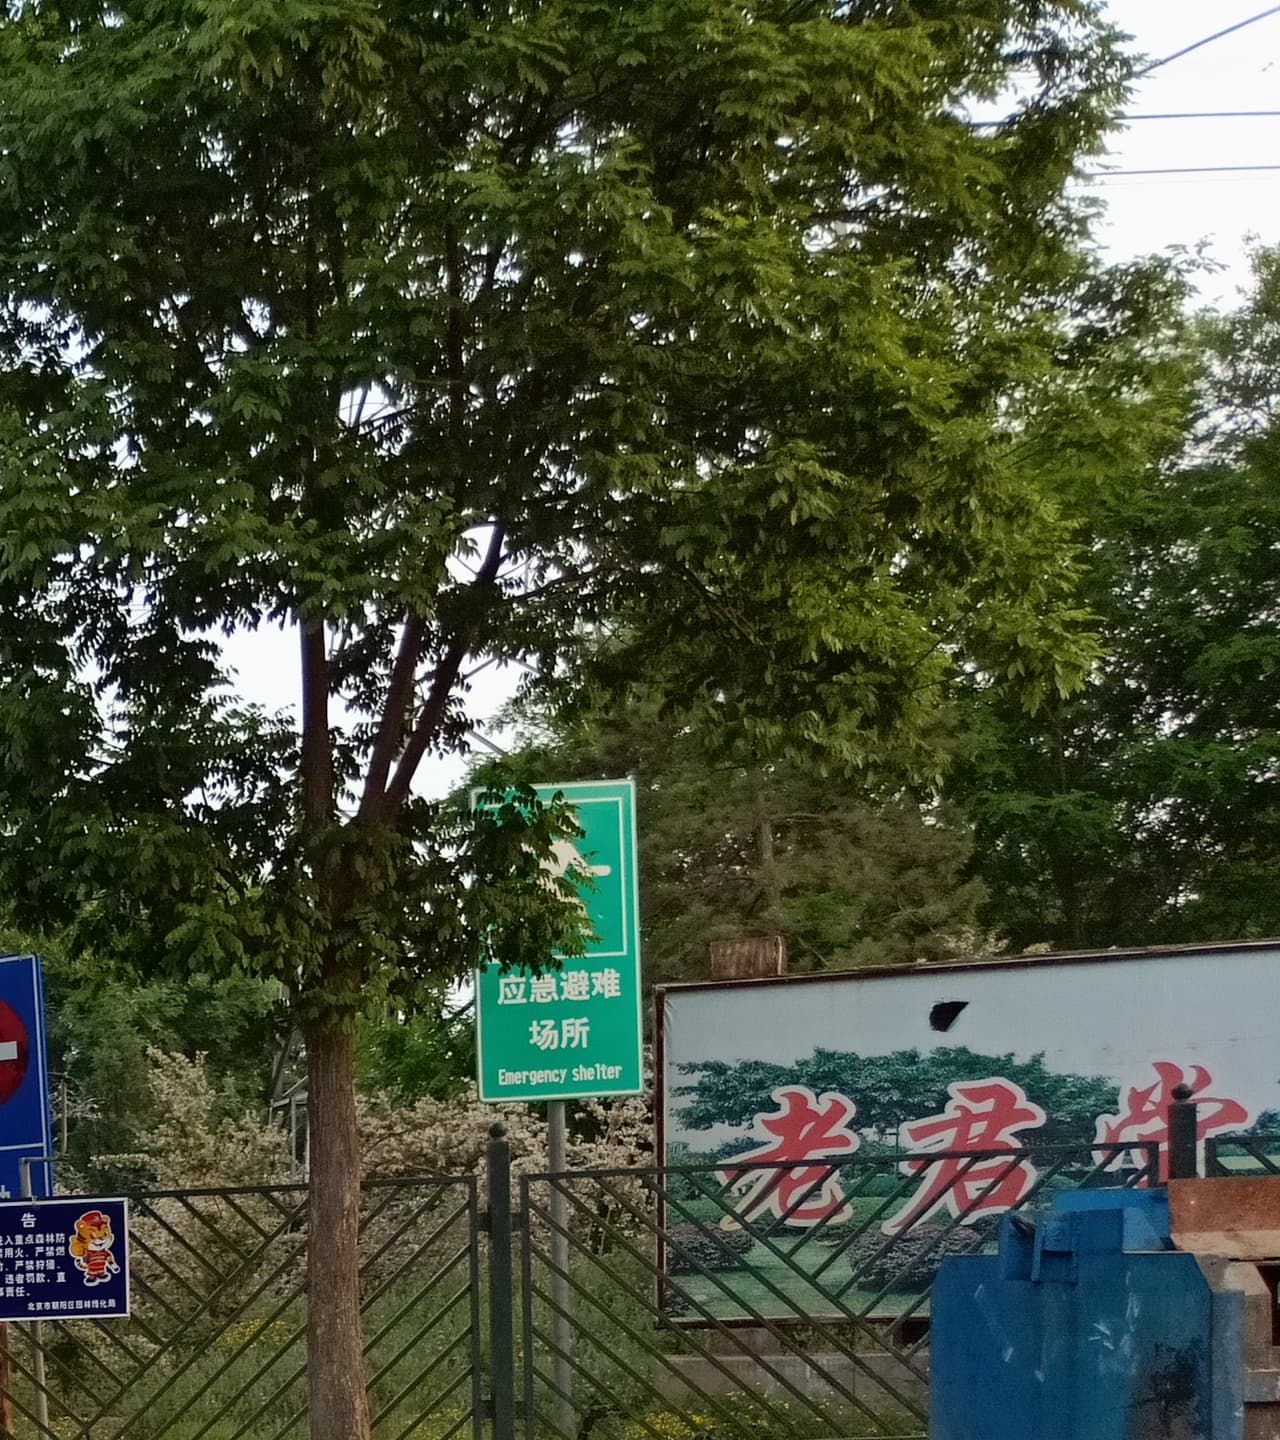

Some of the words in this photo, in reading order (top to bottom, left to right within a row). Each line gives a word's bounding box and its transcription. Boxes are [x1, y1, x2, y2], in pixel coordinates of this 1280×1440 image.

[497, 967, 622, 1005] 应急避难
[528, 1016, 591, 1050] 场所
[497, 1065, 567, 1086] Emergency
[571, 1062, 623, 1082] shelter
[26, 1299, 117, 1312] 北京市朝阳区园林绿化局
